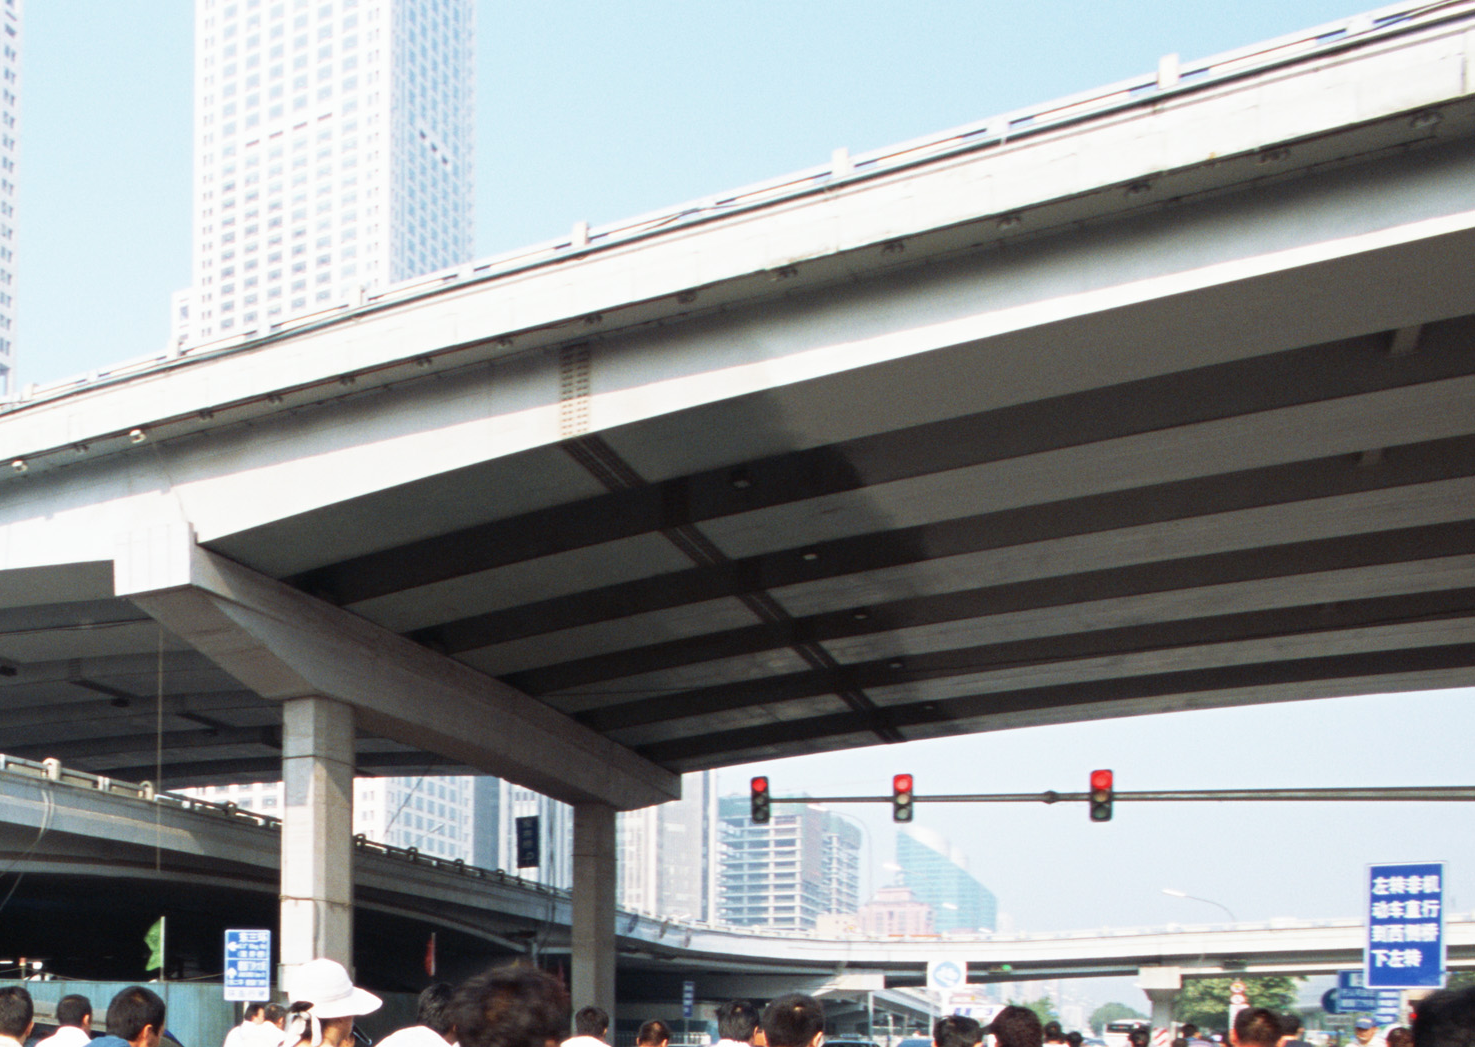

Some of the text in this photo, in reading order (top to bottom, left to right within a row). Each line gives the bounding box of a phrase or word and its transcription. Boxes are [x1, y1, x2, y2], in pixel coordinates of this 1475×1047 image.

[1371, 875, 1441, 895] 左转非机
[1371, 899, 1440, 918] 动车直行
[1370, 948, 1423, 968] 下左转
